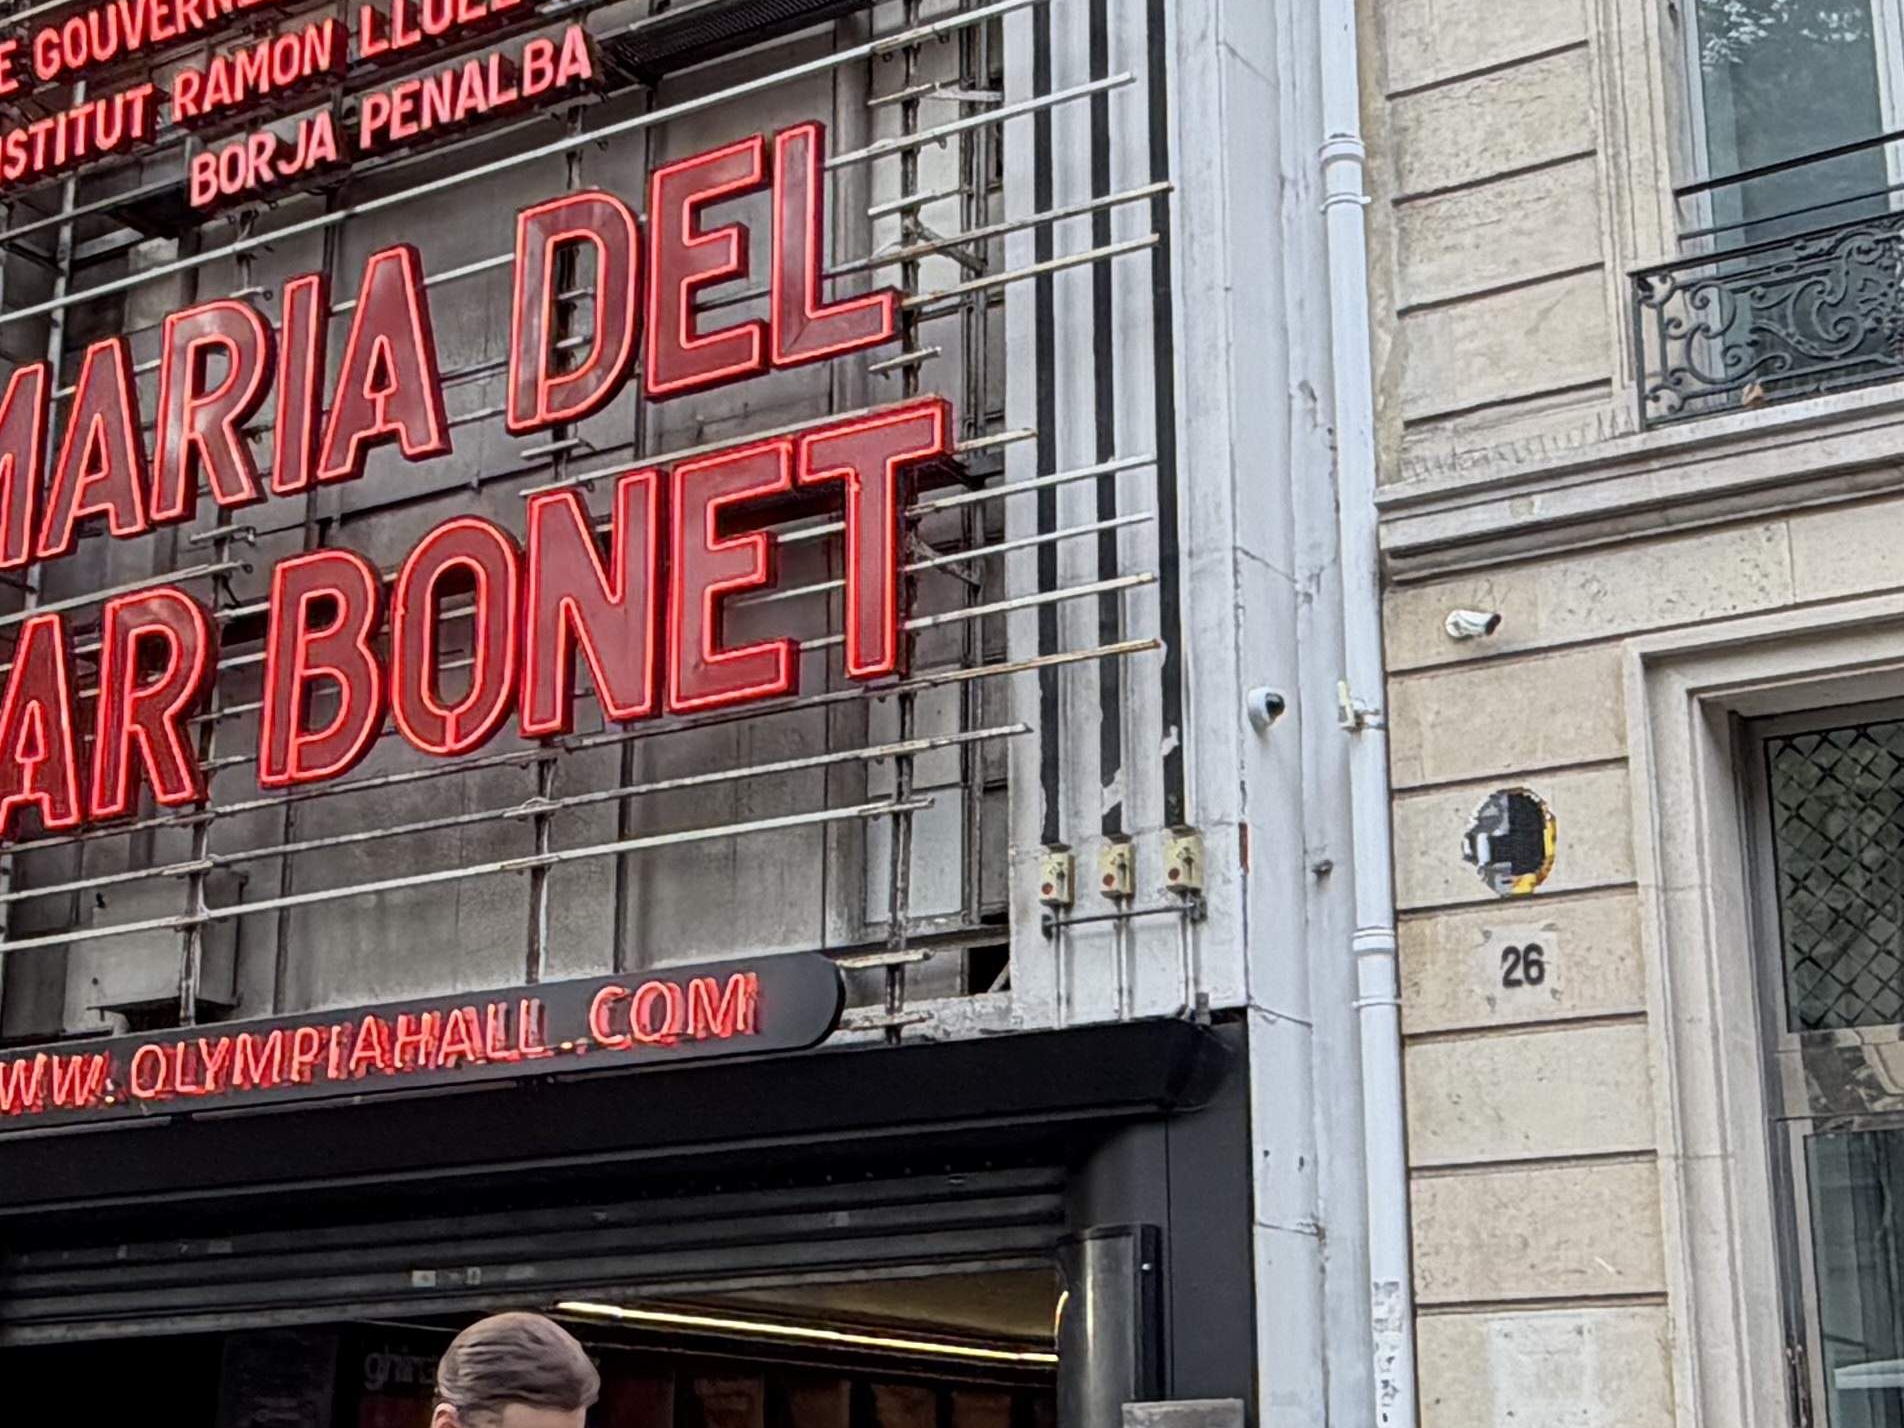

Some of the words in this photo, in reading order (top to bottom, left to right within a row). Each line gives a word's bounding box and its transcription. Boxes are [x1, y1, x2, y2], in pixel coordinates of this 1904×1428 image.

[170, 17, 346, 125] RAMON
[188, 131, 338, 209] BORJA
[359, 25, 593, 152] PENALBA
[504, 118, 899, 438] DEL
[256, 394, 956, 791] BONET
[1501, 943, 1545, 988] 26
